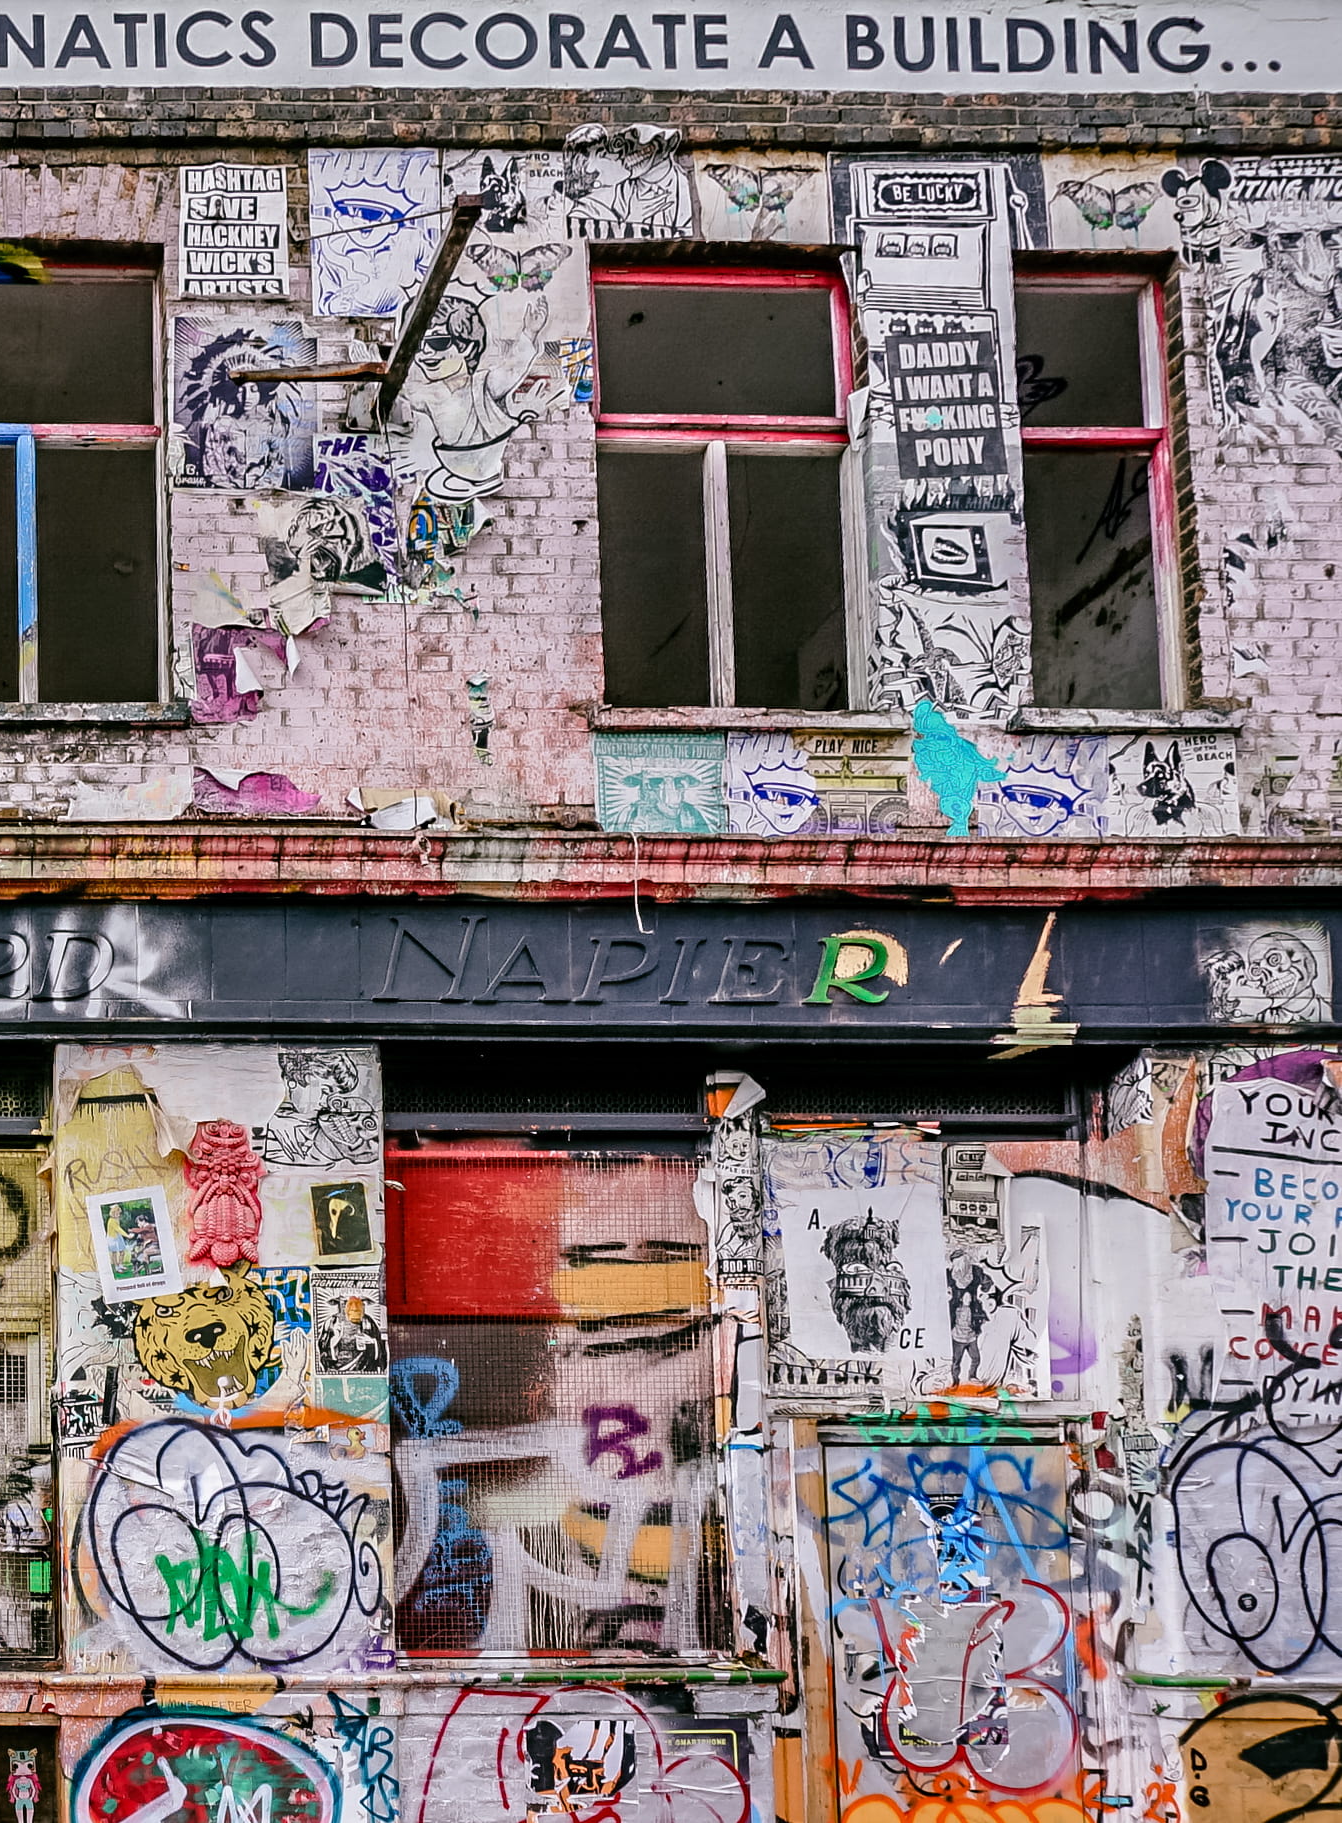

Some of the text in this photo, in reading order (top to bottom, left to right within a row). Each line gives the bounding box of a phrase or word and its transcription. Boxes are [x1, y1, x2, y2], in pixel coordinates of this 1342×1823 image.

[309, 12, 729, 69] DECORATE
[757, 15, 815, 69] A
[845, 16, 1281, 73] BUILDING...
[186, 166, 281, 192] HASHTAG
[892, 184, 963, 202] BE LUCKY
[189, 196, 256, 219] SAVE
[187, 225, 277, 248] HACKNEY
[189, 252, 273, 274] WICK'S
[188, 280, 280, 296] ARTISTS
[898, 340, 980, 370] DADDY
[893, 372, 995, 401] I WANT A
[317, 435, 368, 456] THE
[914, 436, 985, 467] PONY
[966, 495, 1016, 511] MINUT
[814, 739, 879, 754] PLAY NICE
[1184, 735, 1217, 746] HERO
[1196, 751, 1233, 762] BEACH
[372, 914, 891, 1005] NAPIER
[1238, 1089, 1334, 1125] YOUR
[1255, 1168, 1339, 1201] BECO
[1225, 1197, 1313, 1225] YOUR
[312, 1280, 355, 1289] FIGHTING
